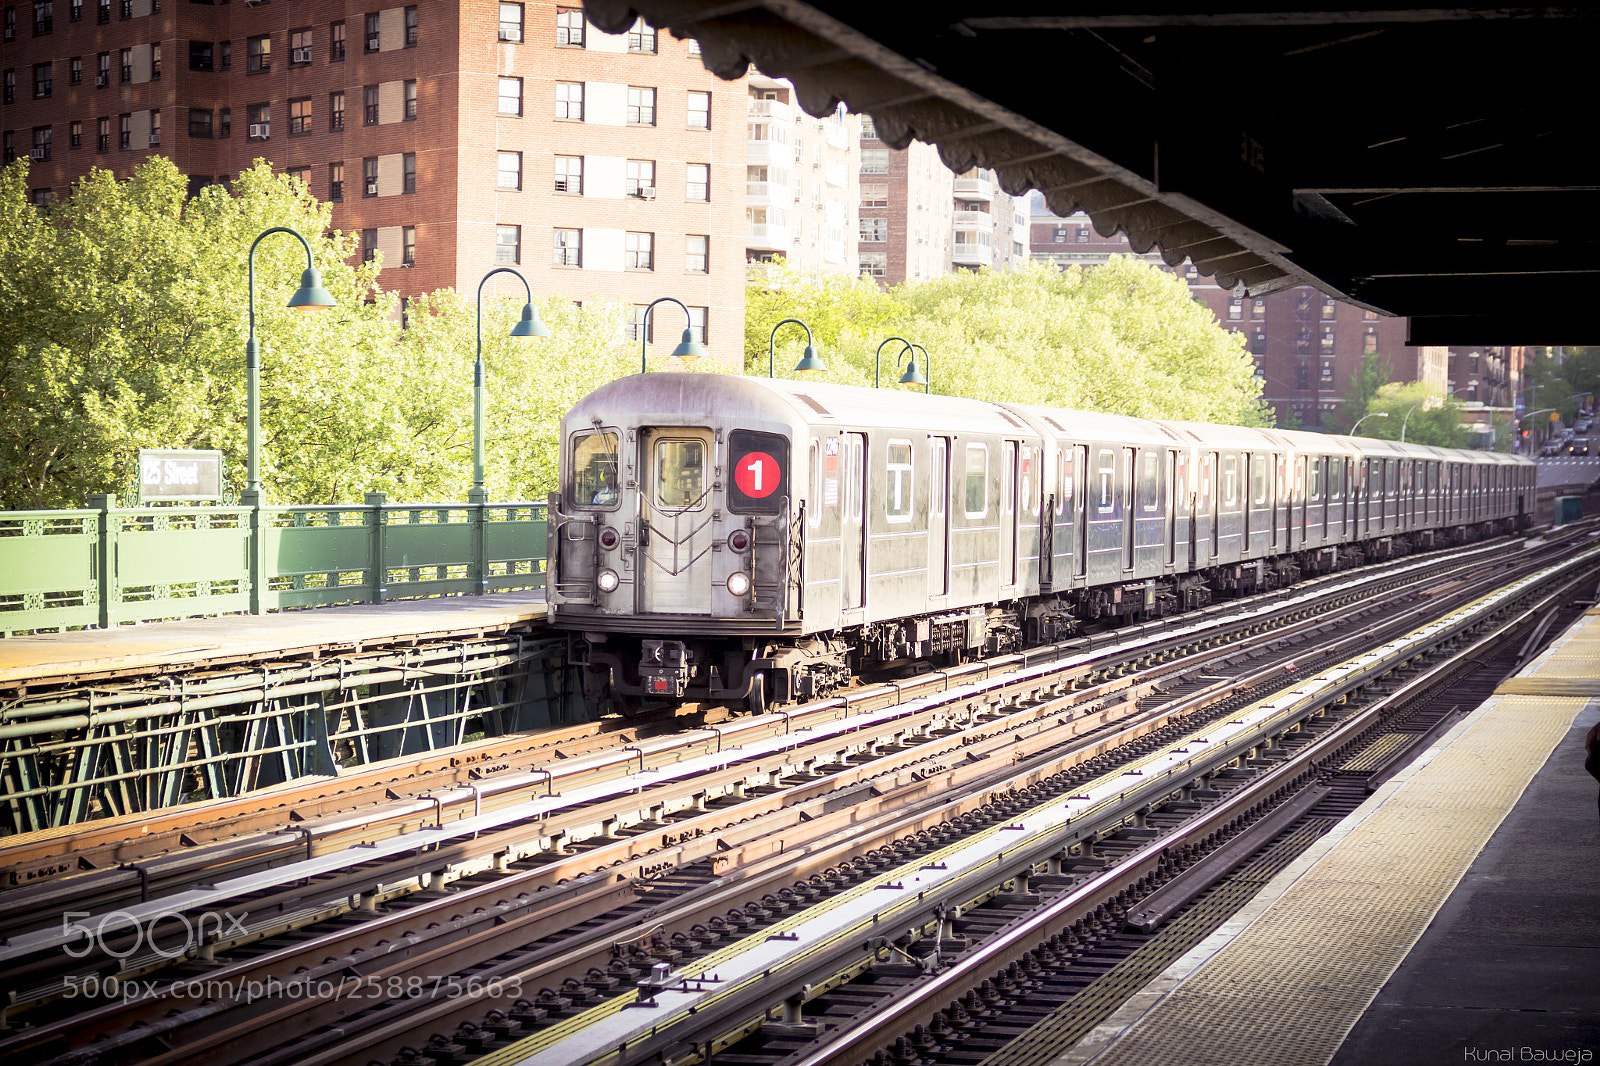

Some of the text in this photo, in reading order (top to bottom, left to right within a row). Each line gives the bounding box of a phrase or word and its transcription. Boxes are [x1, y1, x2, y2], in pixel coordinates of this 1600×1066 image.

[142, 460, 199, 485] 125 Street
[747, 460, 763, 491] 1
